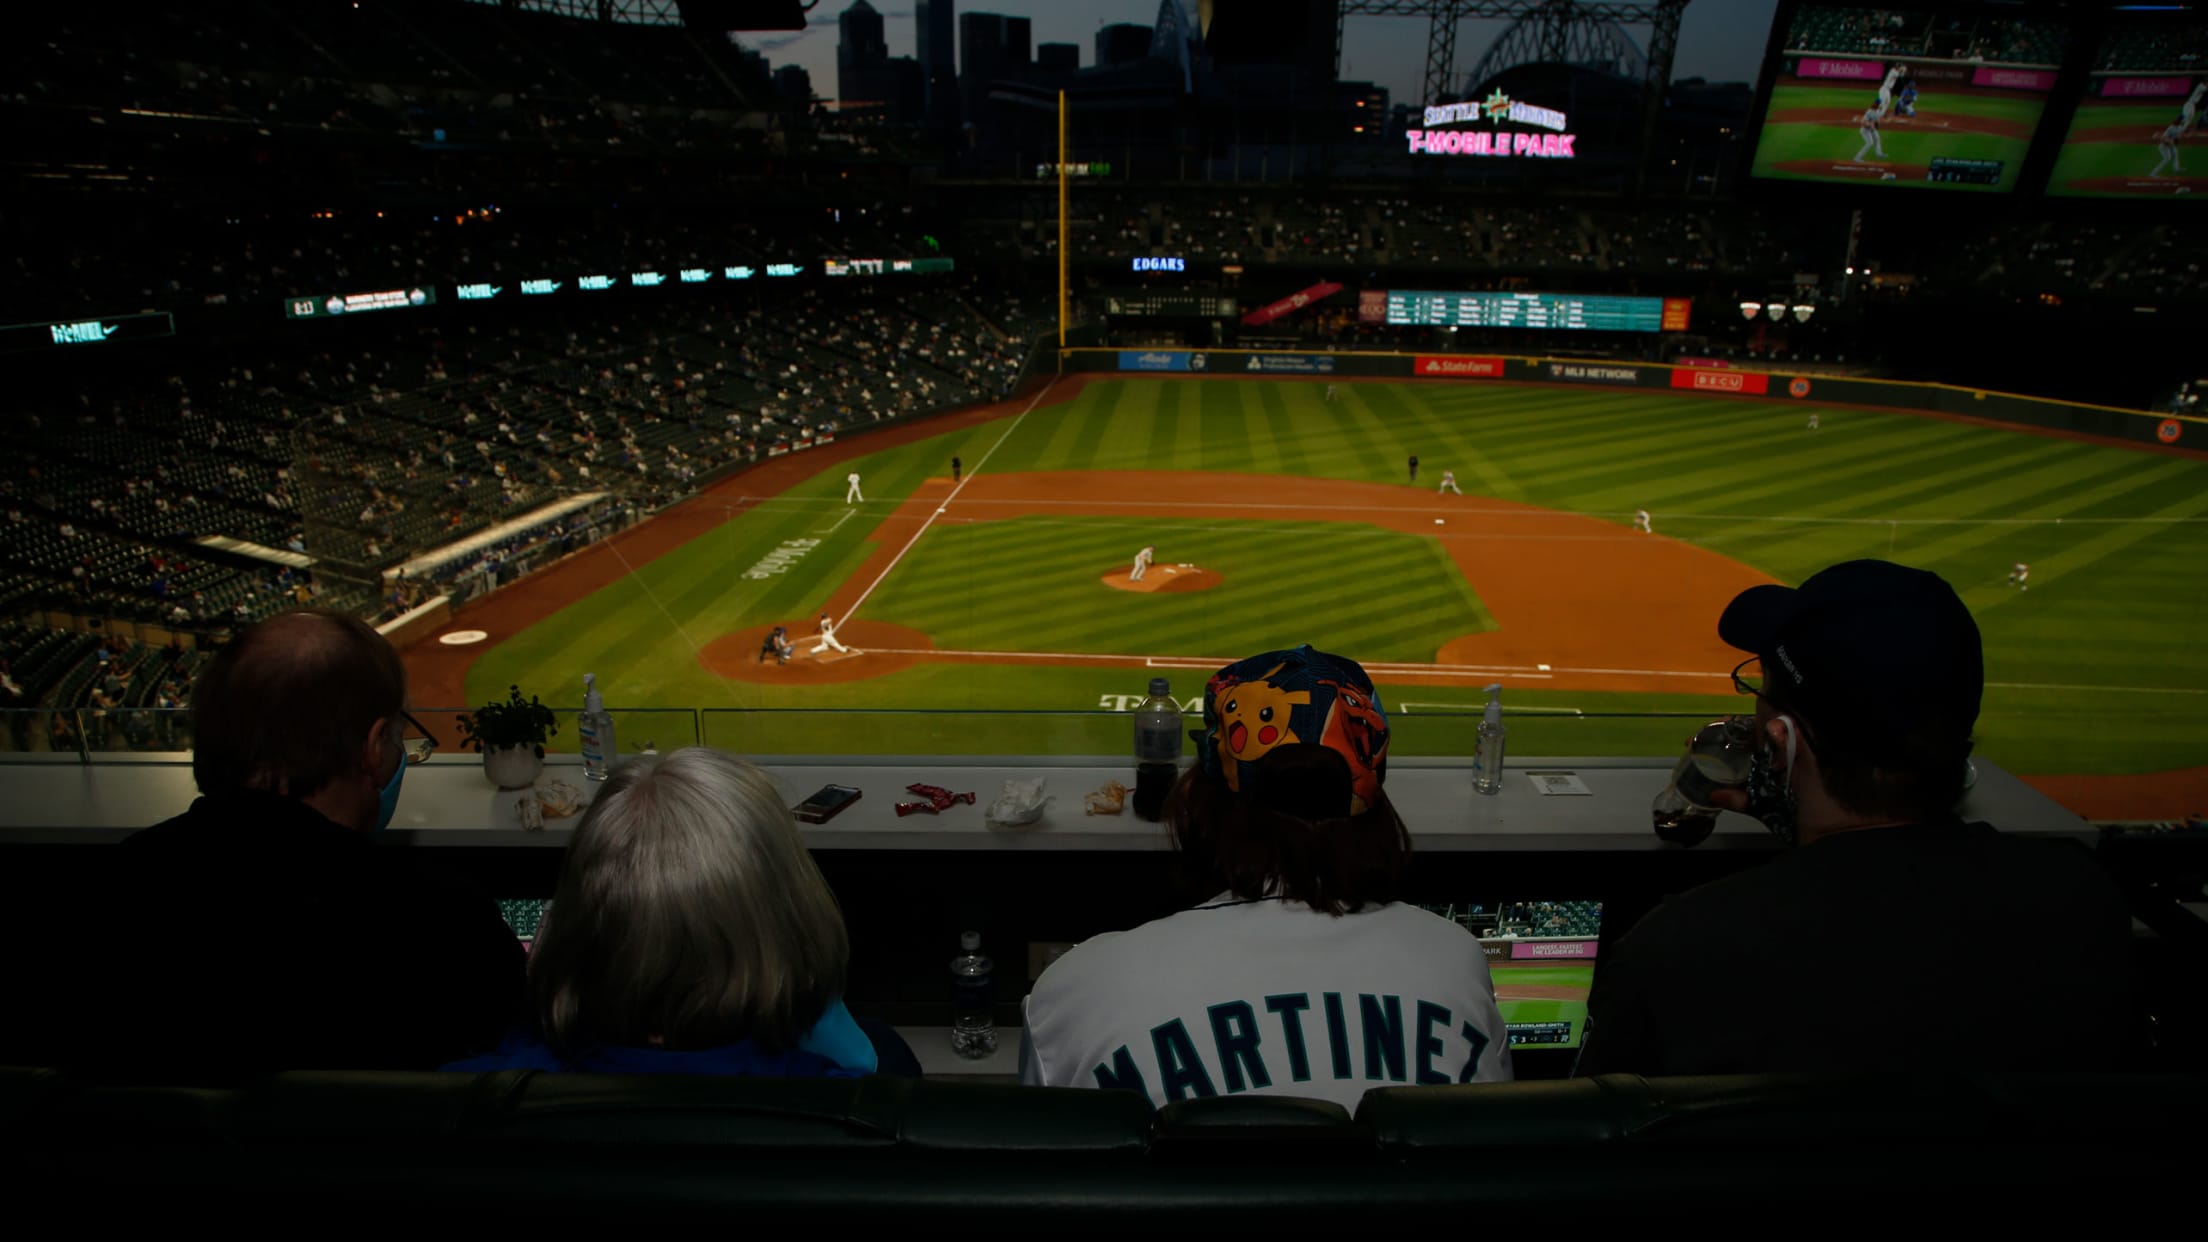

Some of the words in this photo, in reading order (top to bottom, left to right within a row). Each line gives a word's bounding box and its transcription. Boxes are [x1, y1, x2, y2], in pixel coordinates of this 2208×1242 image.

[1406, 129, 1511, 156] T-MOBILE
[1514, 131, 1577, 158] PARK
[1565, 366, 1586, 378] MLB
[1587, 367, 1637, 381] NETWORK
[1698, 375, 1740, 388] BECU
